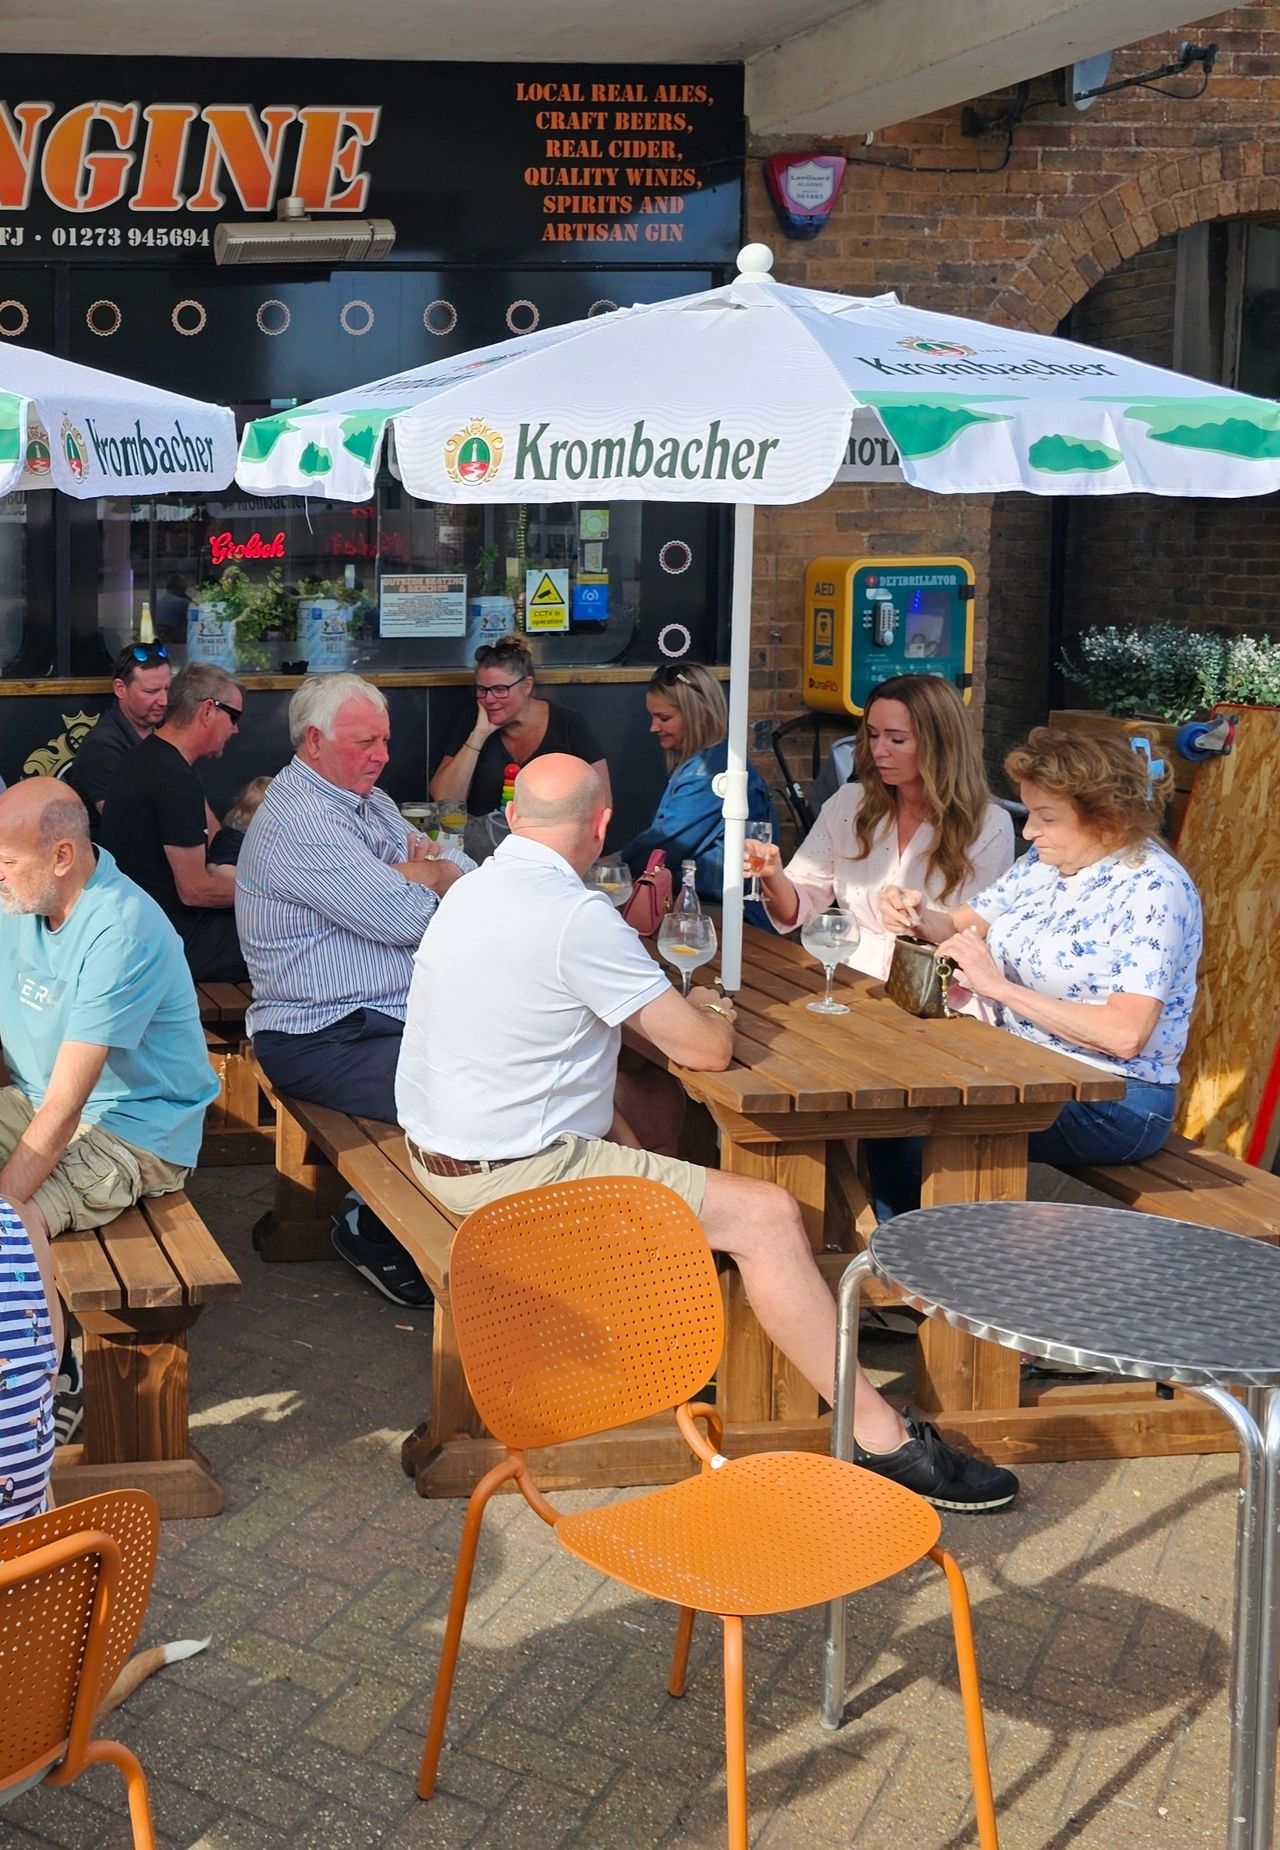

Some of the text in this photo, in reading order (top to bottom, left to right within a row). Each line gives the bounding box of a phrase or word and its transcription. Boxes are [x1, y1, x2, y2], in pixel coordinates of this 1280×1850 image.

[515, 83, 714, 105] LOCAL REAL ALES,
[535, 111, 694, 134] CRAFT BEERS,
[545, 139, 683, 160] REAL CIDER,
[524, 167, 703, 189] QUALITY WINES,
[543, 195, 685, 214] SPIRITS AND
[52, 228, 121, 247] 01273
[127, 228, 211, 247] 945694
[541, 223, 685, 241] ARTISAN GIN
[854, 356, 1120, 377] Krombacher
[513, 421, 782, 482] Krombacher
[209, 531, 286, 566] Grolsch
[814, 582, 836, 597] AED
[878, 575, 957, 587] DEFIBRILLATOR
[531, 618, 563, 626] operation
